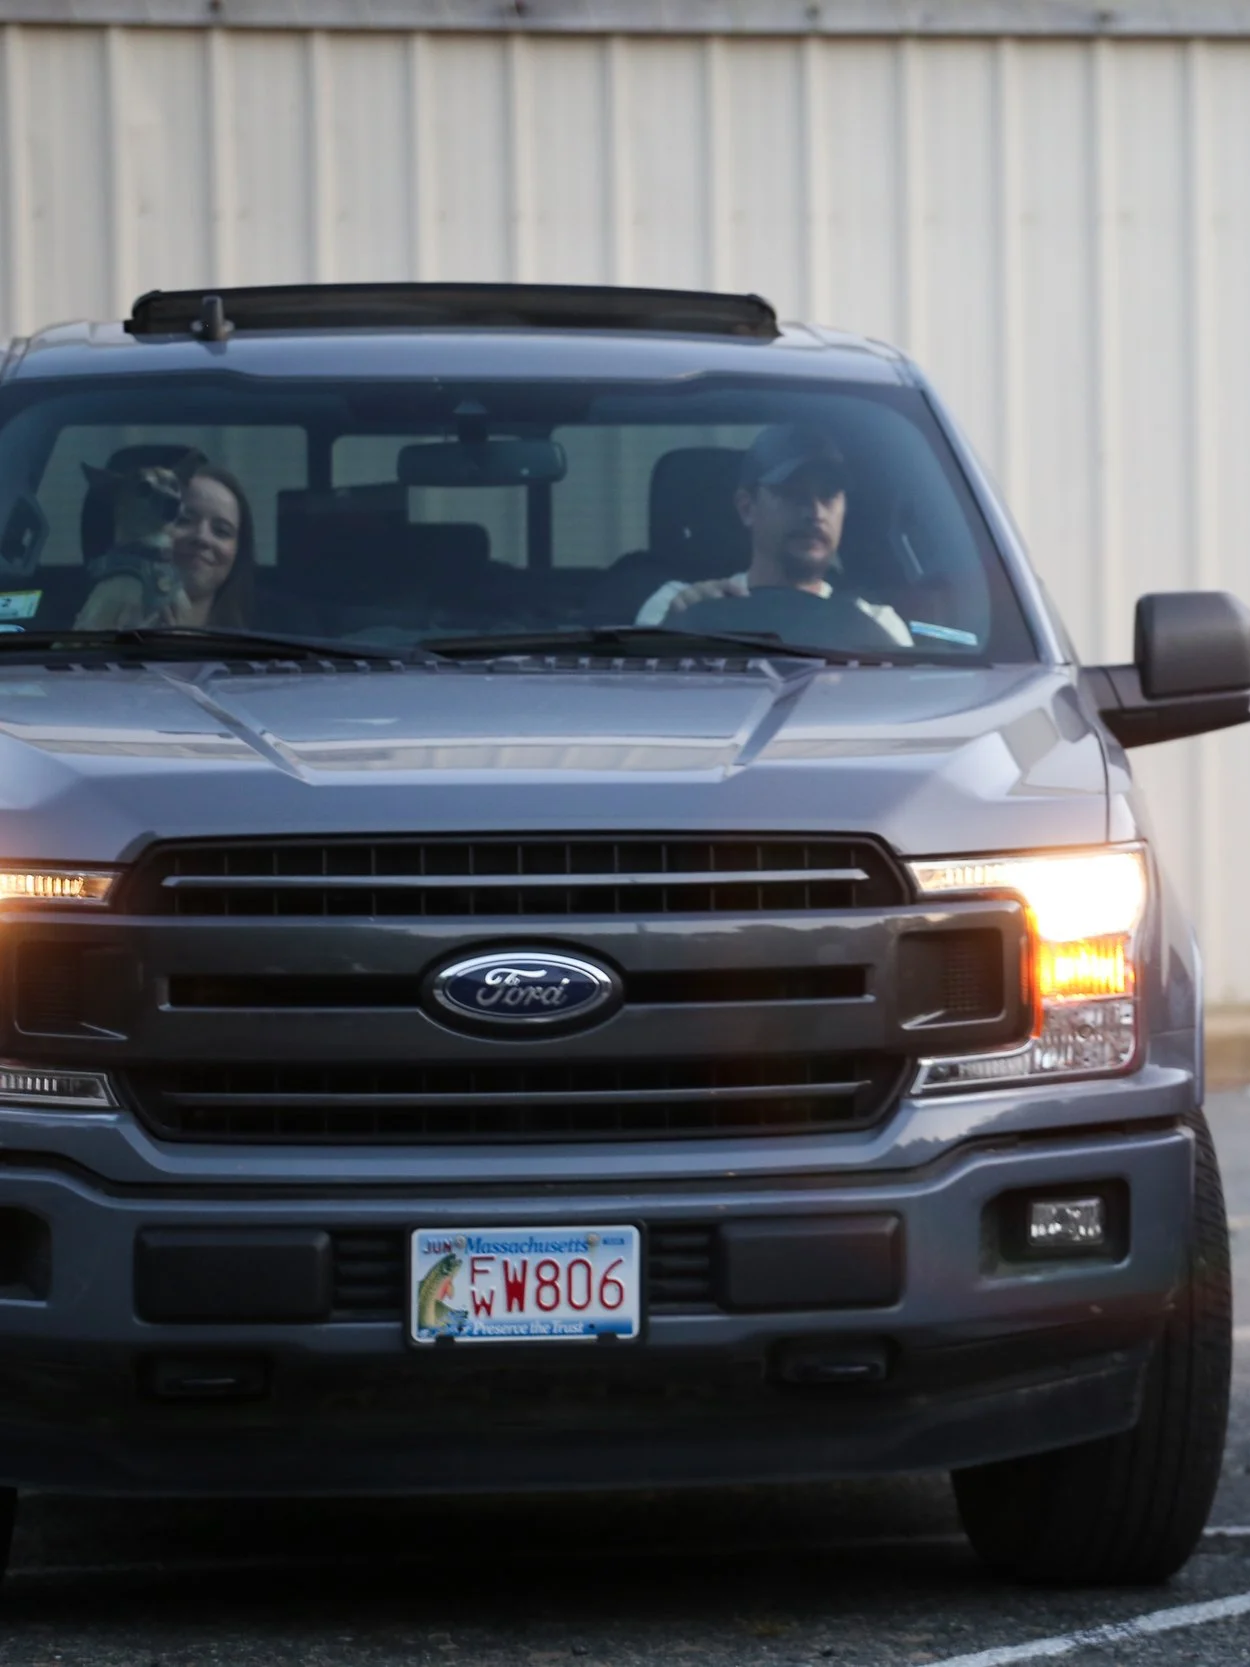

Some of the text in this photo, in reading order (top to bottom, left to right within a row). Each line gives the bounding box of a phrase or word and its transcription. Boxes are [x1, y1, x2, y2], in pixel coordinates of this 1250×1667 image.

[476, 967, 570, 1006] Ford
[422, 1238, 453, 1254] JUN
[466, 1236, 590, 1255] Massachusetts
[473, 1320, 585, 1336] Preserve the Trust
